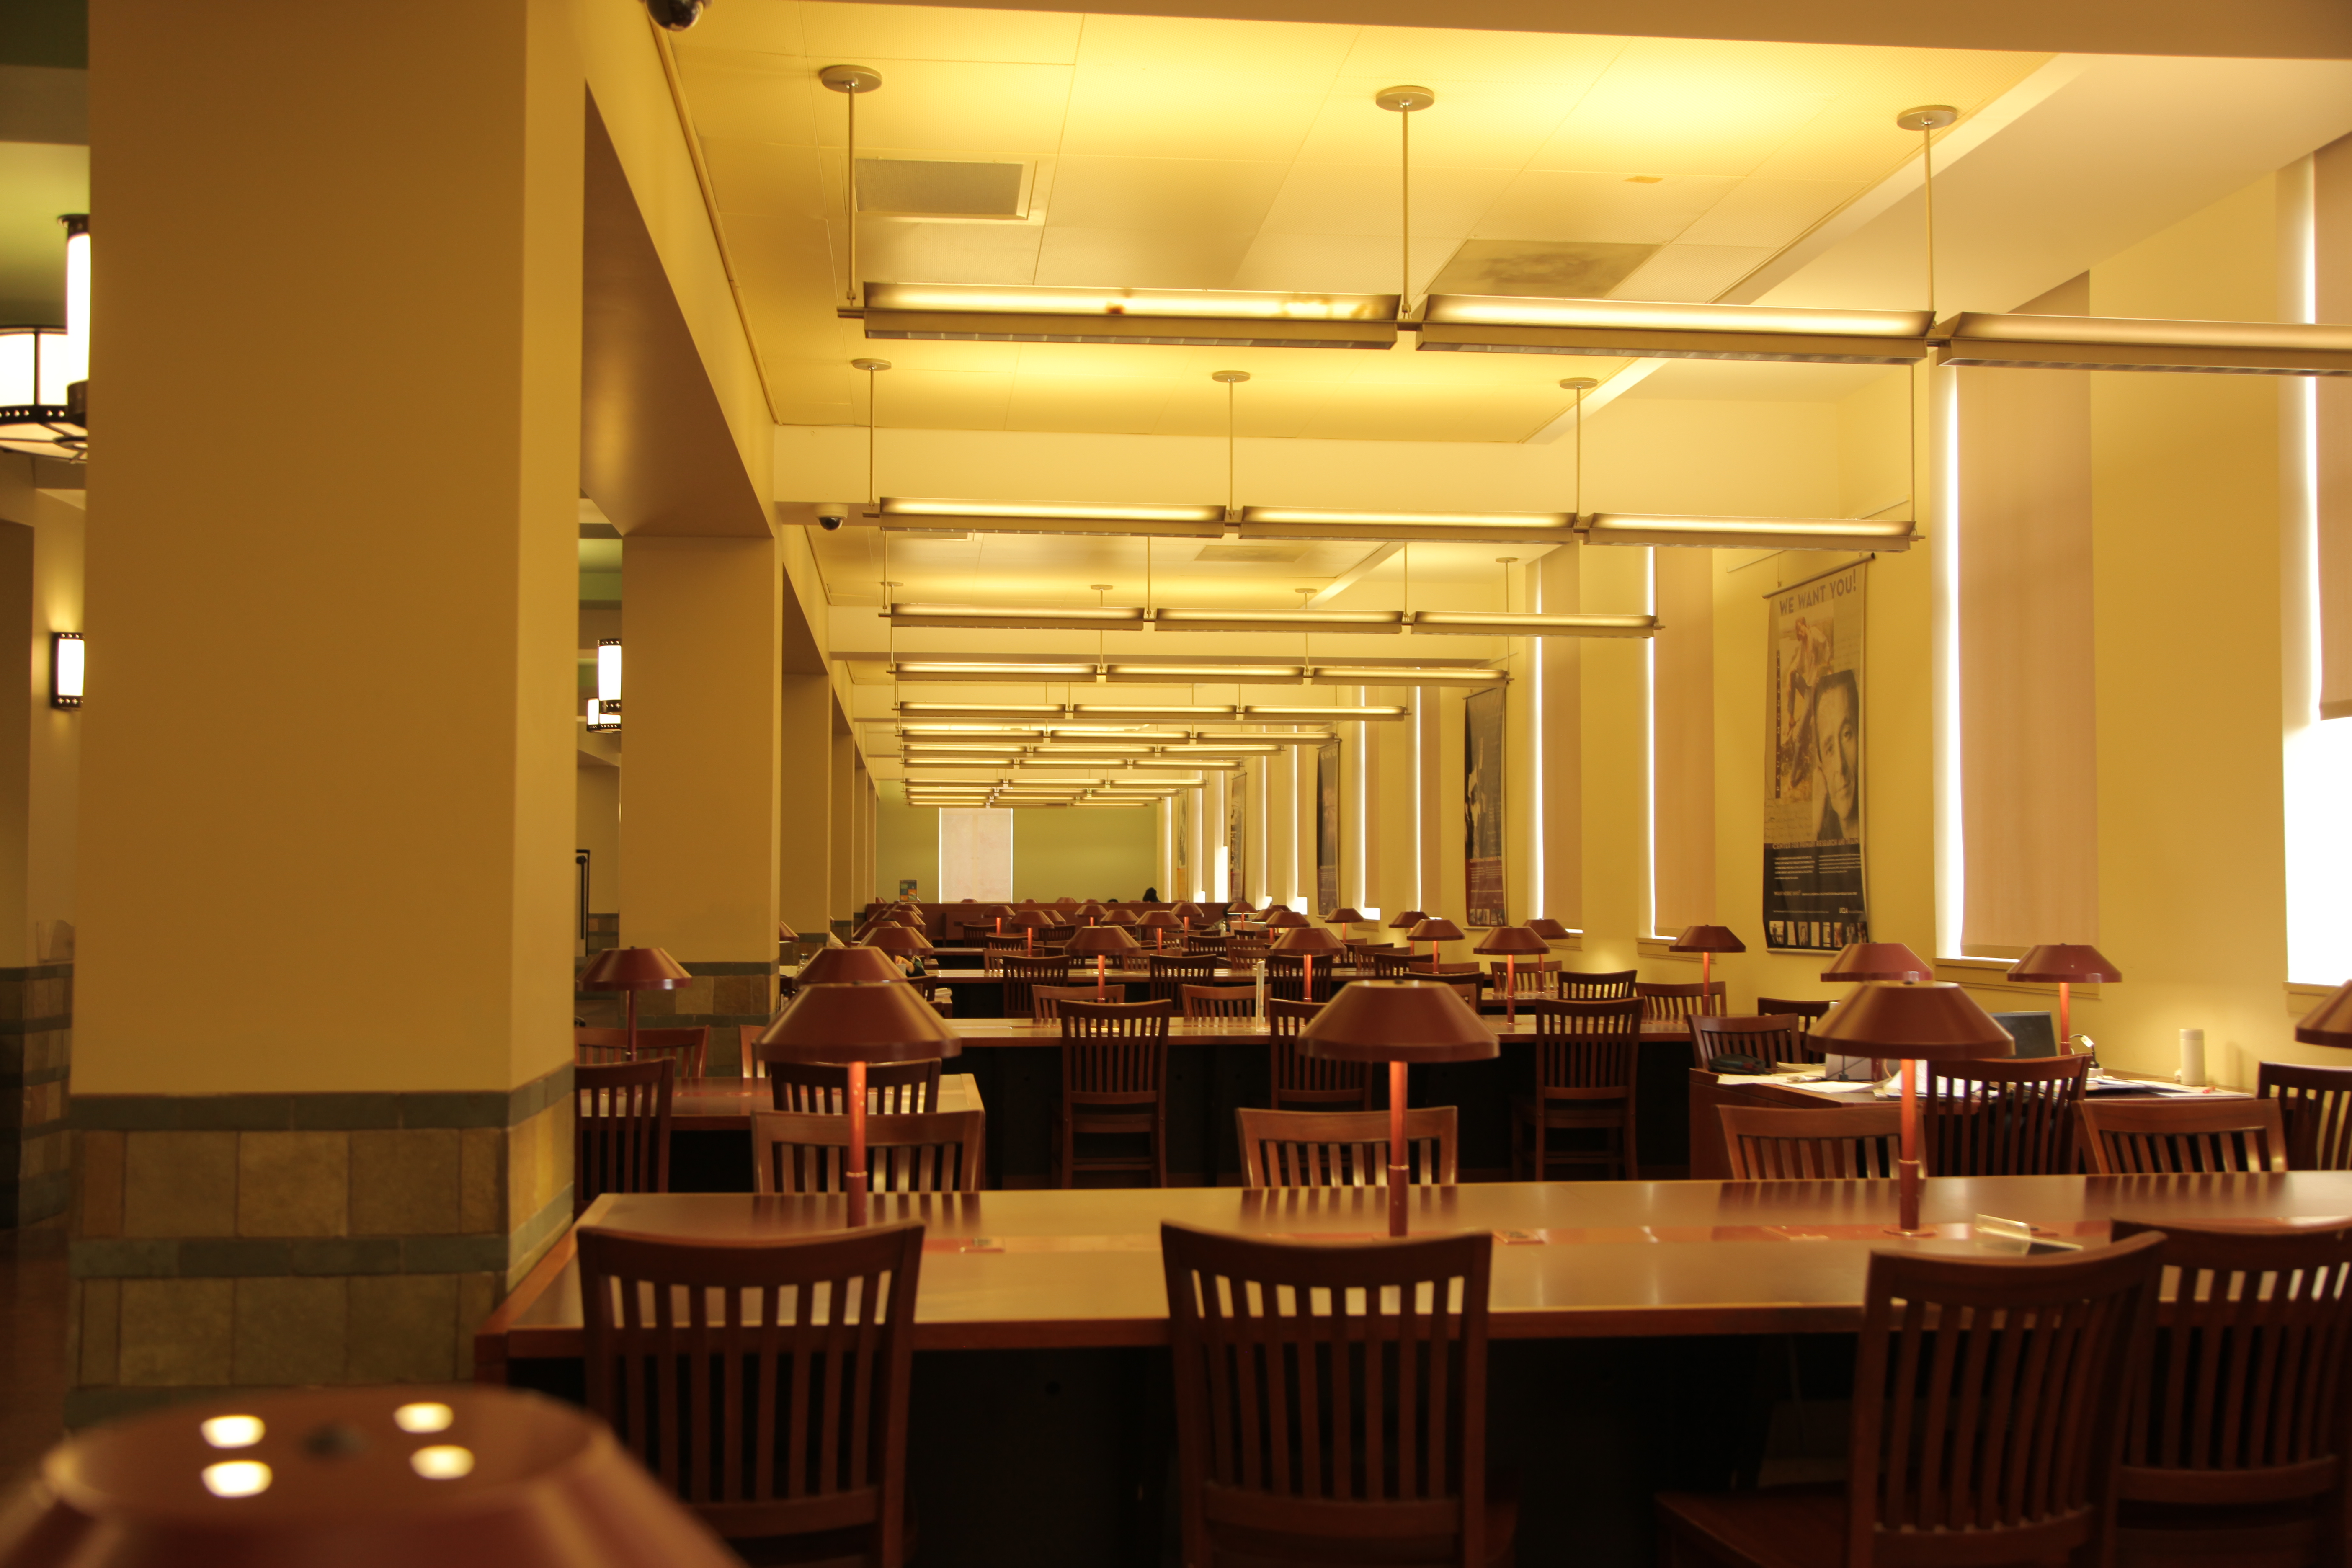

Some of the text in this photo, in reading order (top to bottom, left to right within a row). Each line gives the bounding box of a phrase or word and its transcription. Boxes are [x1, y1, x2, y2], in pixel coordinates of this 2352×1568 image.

[1780, 568, 1856, 616] WE WANT YOU!
